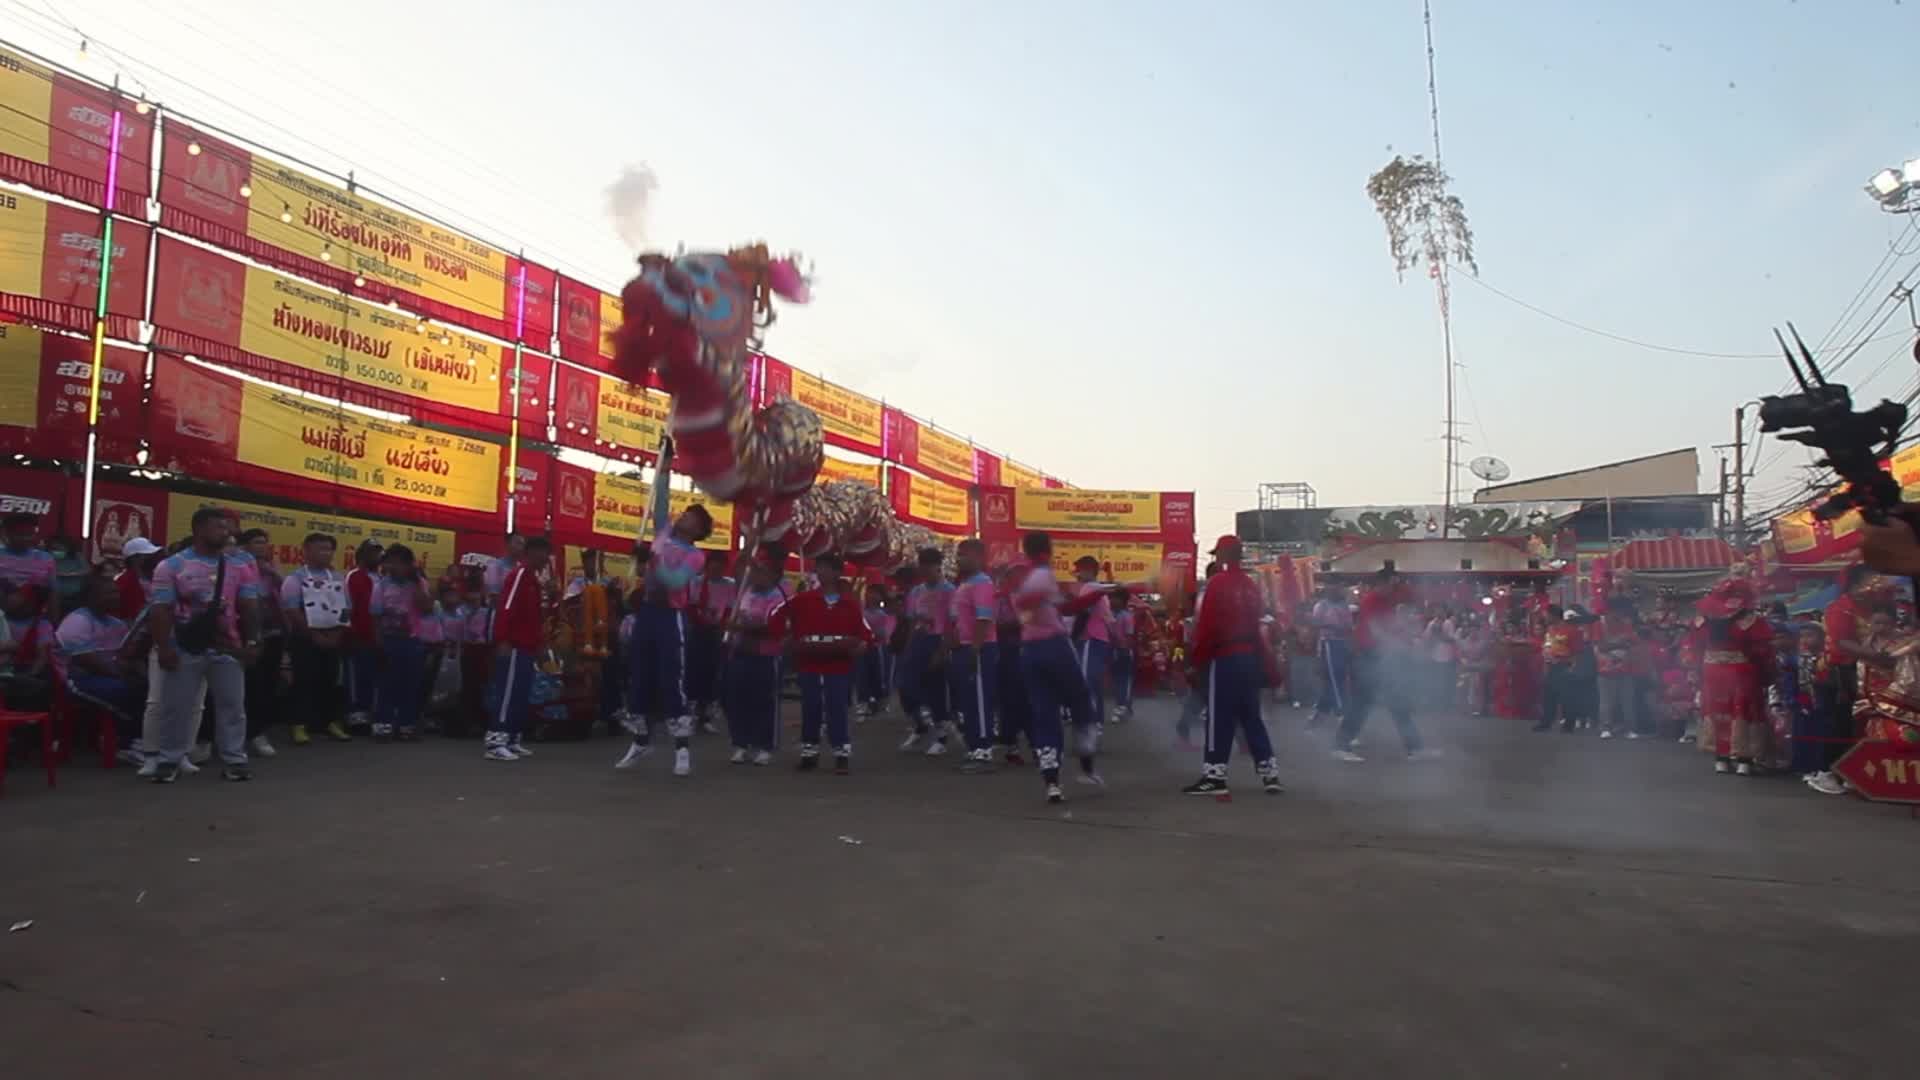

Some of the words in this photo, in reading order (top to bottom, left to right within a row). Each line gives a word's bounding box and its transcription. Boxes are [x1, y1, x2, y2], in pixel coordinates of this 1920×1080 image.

[272, 302, 393, 359] ห้างทองเยาวราช
[356, 363, 404, 386] 150,000
